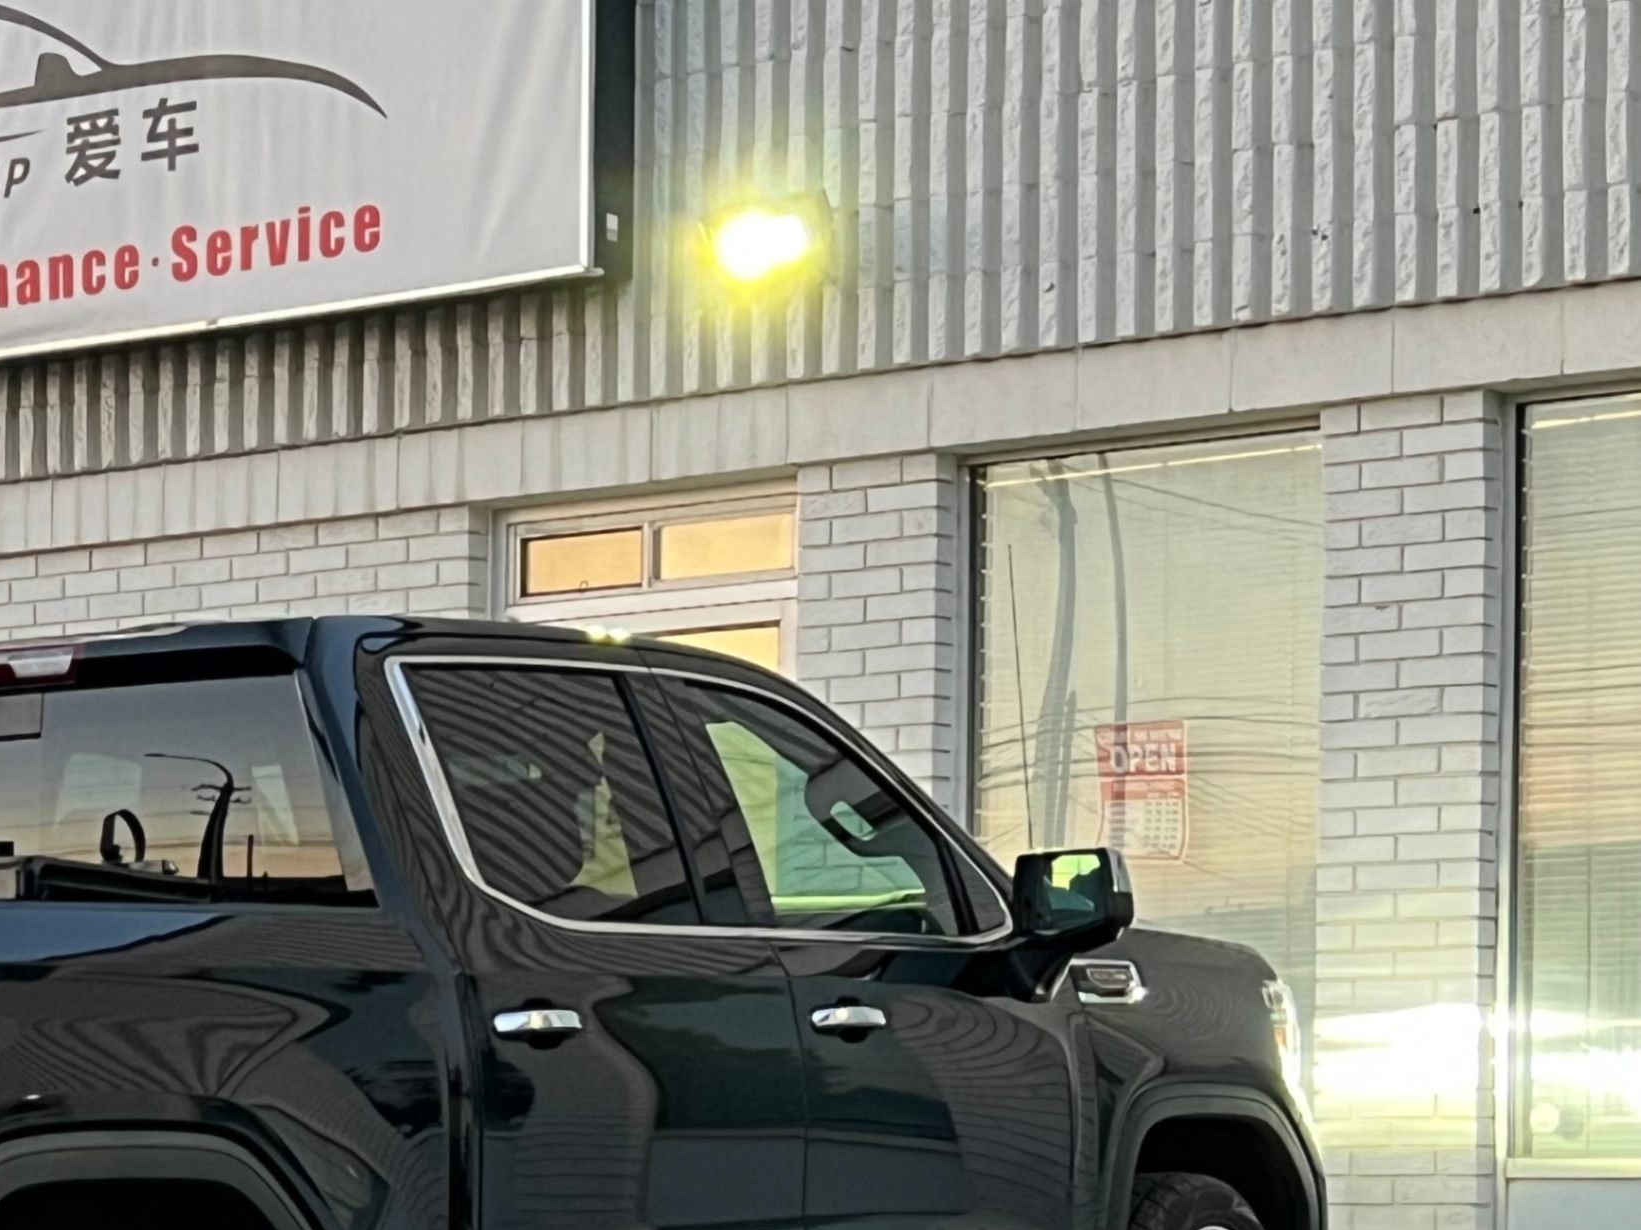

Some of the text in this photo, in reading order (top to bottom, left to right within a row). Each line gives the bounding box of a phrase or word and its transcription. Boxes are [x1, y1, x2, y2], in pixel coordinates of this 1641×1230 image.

[64, 97, 200, 187] 爱车
[171, 204, 382, 282] Service
[1110, 743, 1177, 774] OPEN
